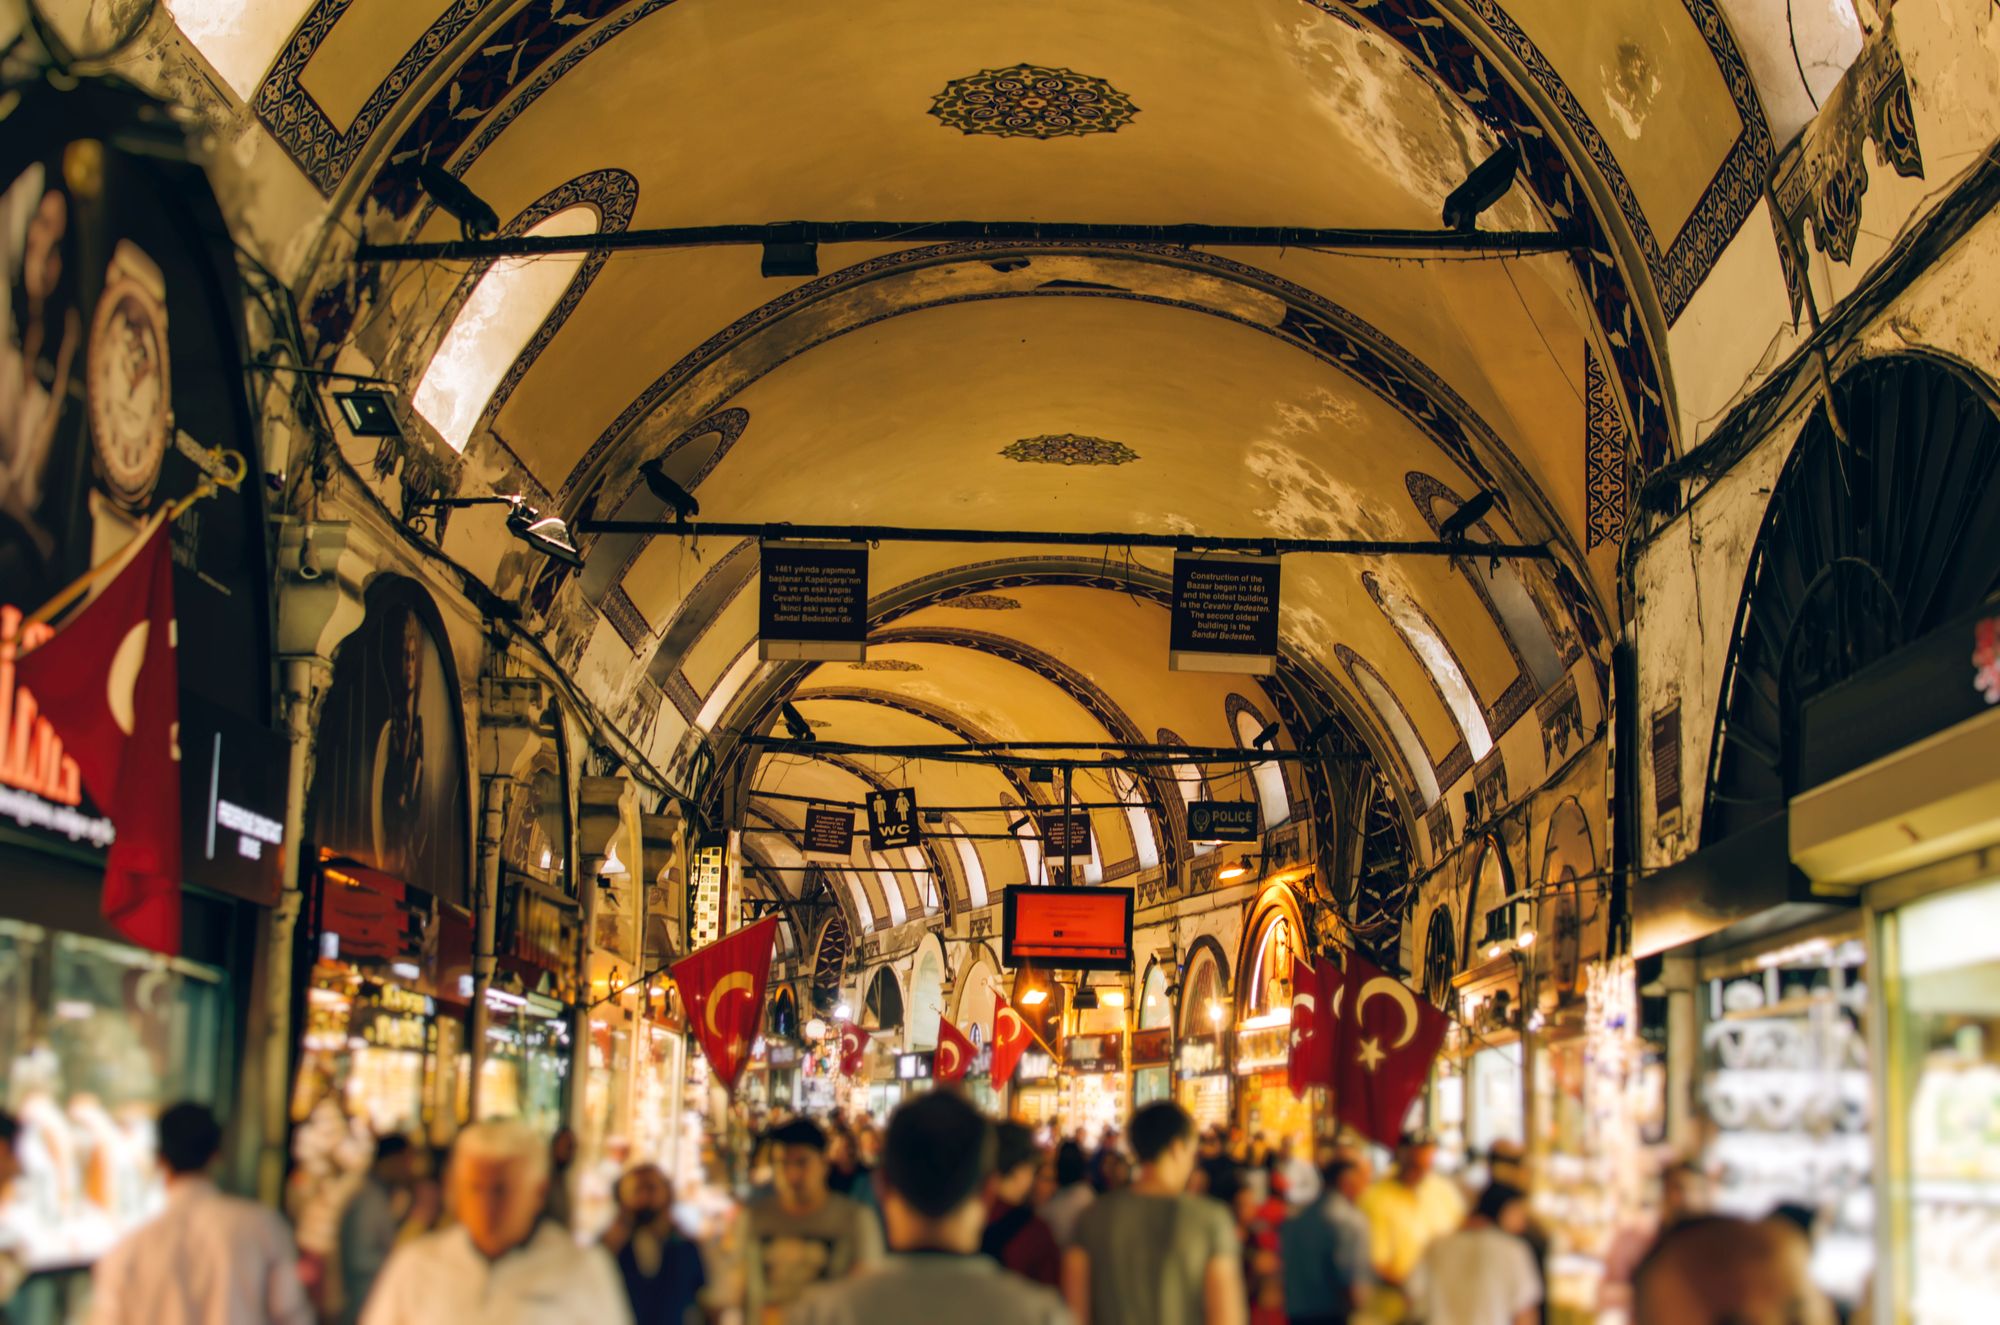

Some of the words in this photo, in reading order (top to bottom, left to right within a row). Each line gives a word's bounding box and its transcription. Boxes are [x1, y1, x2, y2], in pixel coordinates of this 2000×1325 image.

[1191, 572, 1239, 581] Construction
[1186, 581, 1212, 589] Bazaar
[1214, 583, 1237, 592] began
[1238, 594, 1268, 604] building
[1203, 602, 1232, 610] Cevahir
[1191, 610, 1204, 619] The
[1198, 622, 1228, 631] building
[1192, 630, 1218, 638] Sandal
[879, 824, 910, 836] WC
